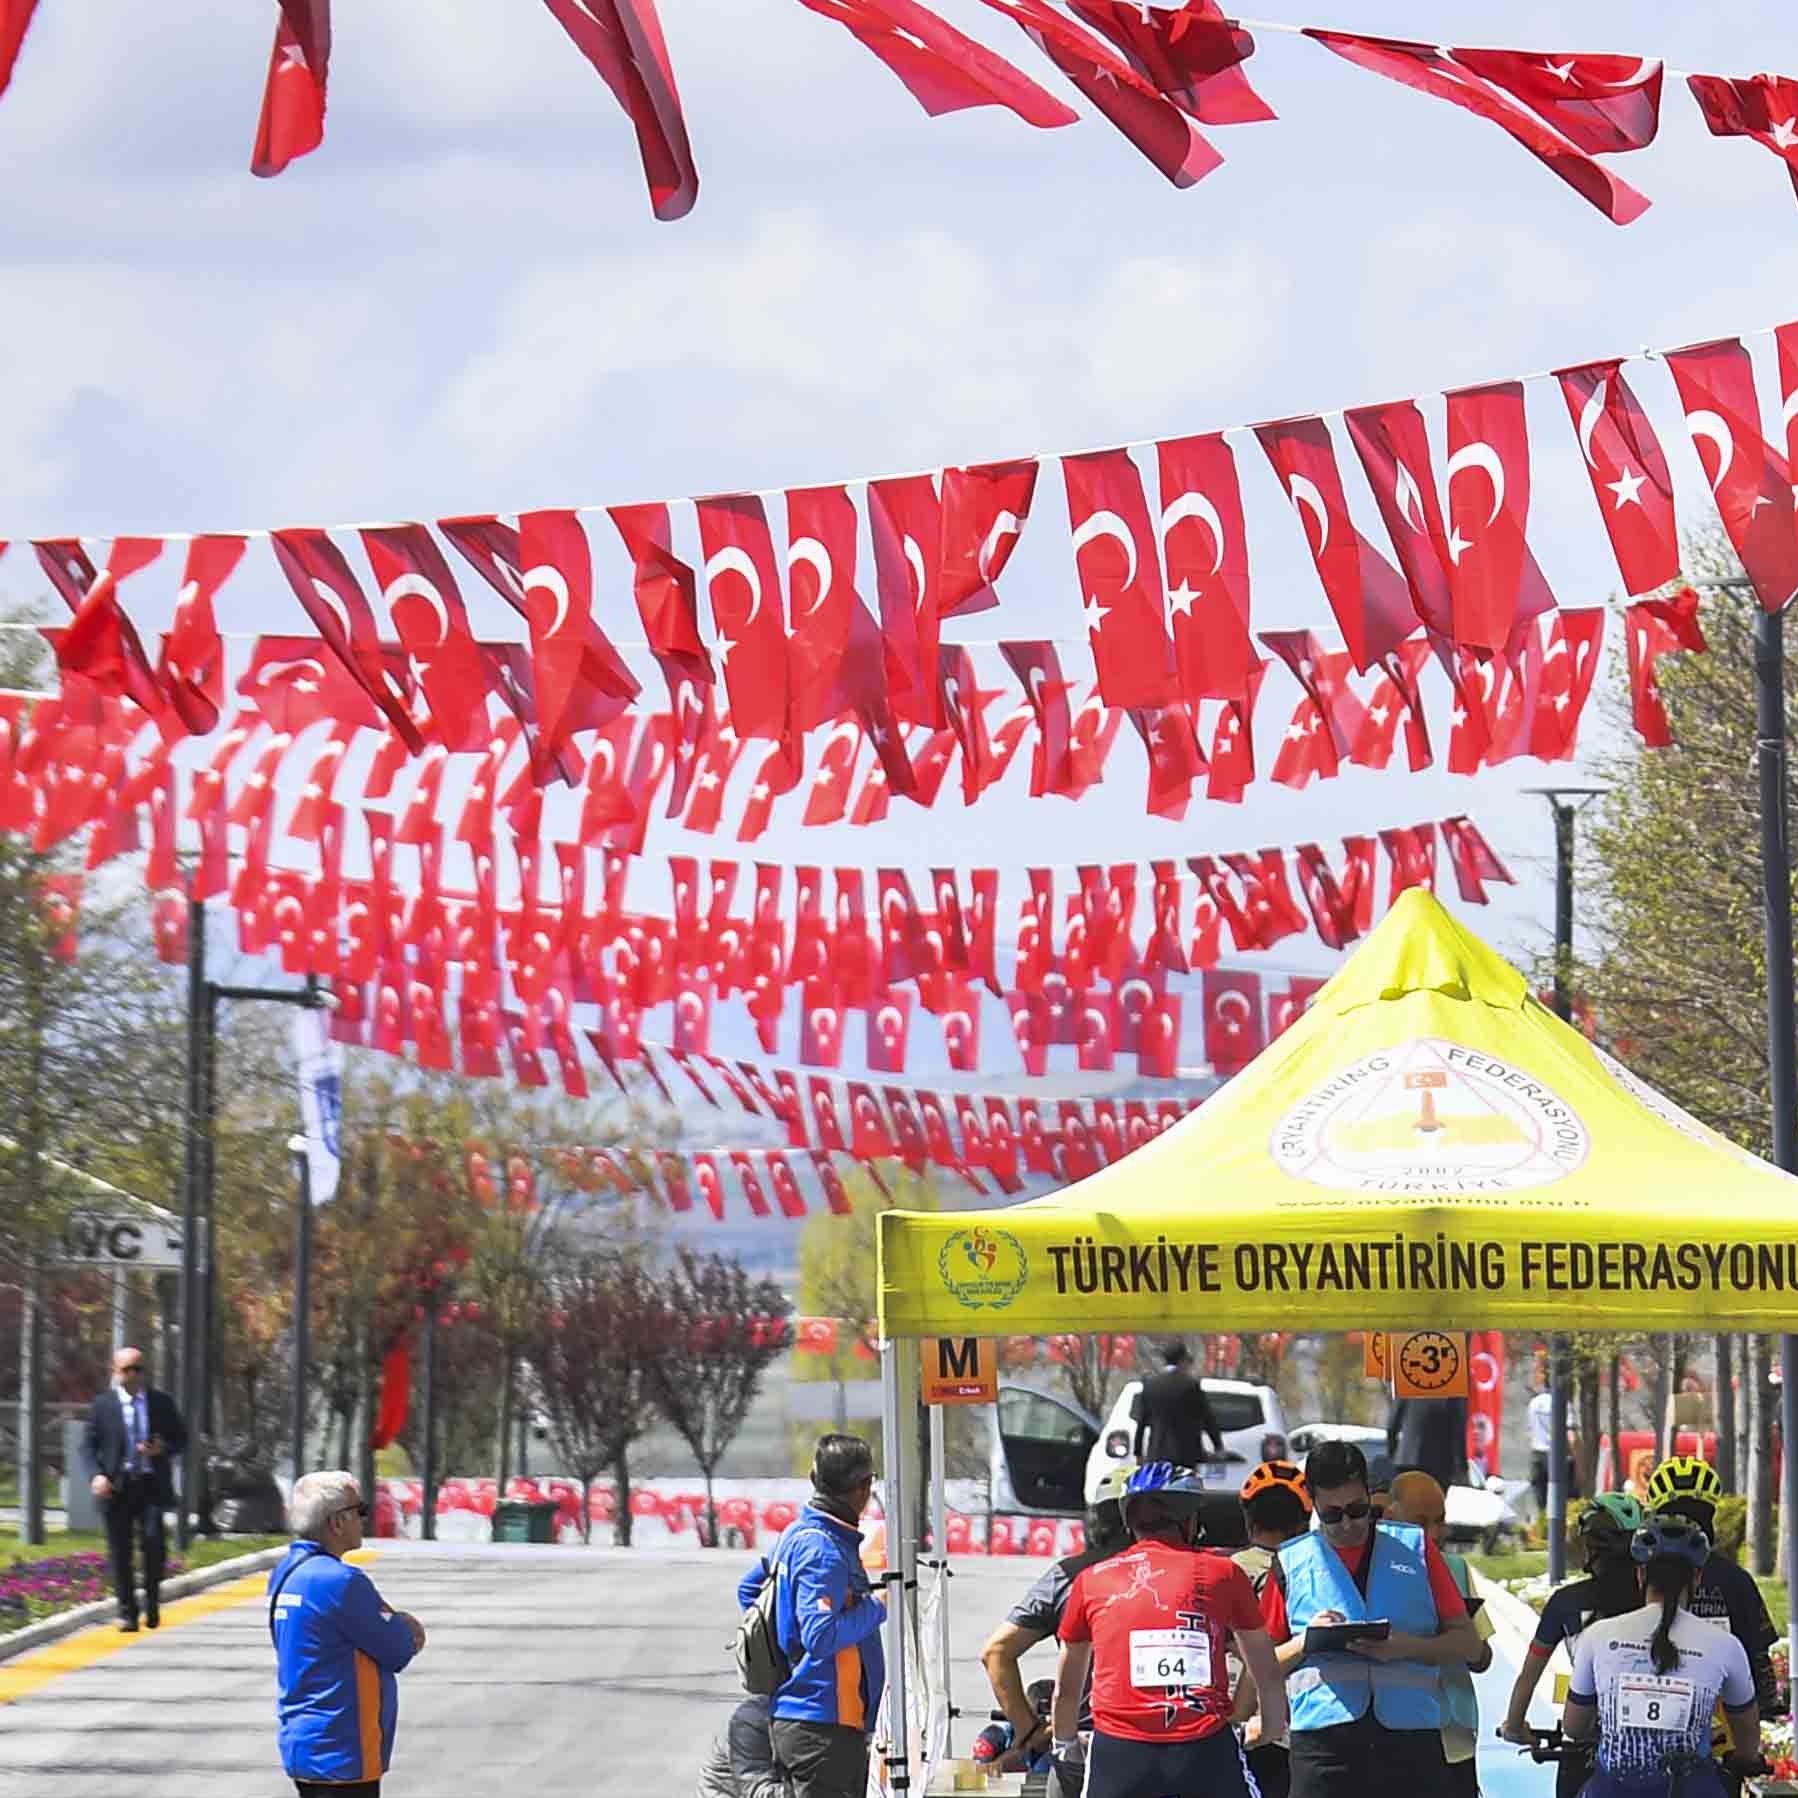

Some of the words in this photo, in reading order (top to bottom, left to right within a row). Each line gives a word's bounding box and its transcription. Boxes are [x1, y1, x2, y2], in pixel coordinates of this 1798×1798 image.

[1046, 1235, 1222, 1294] TÜRKİYE
[1234, 1232, 1506, 1292] ORYANTİRİNG
[937, 1337, 978, 1378] M
[1157, 1656, 1188, 1678] 64
[1646, 1701, 1661, 1722] 8
